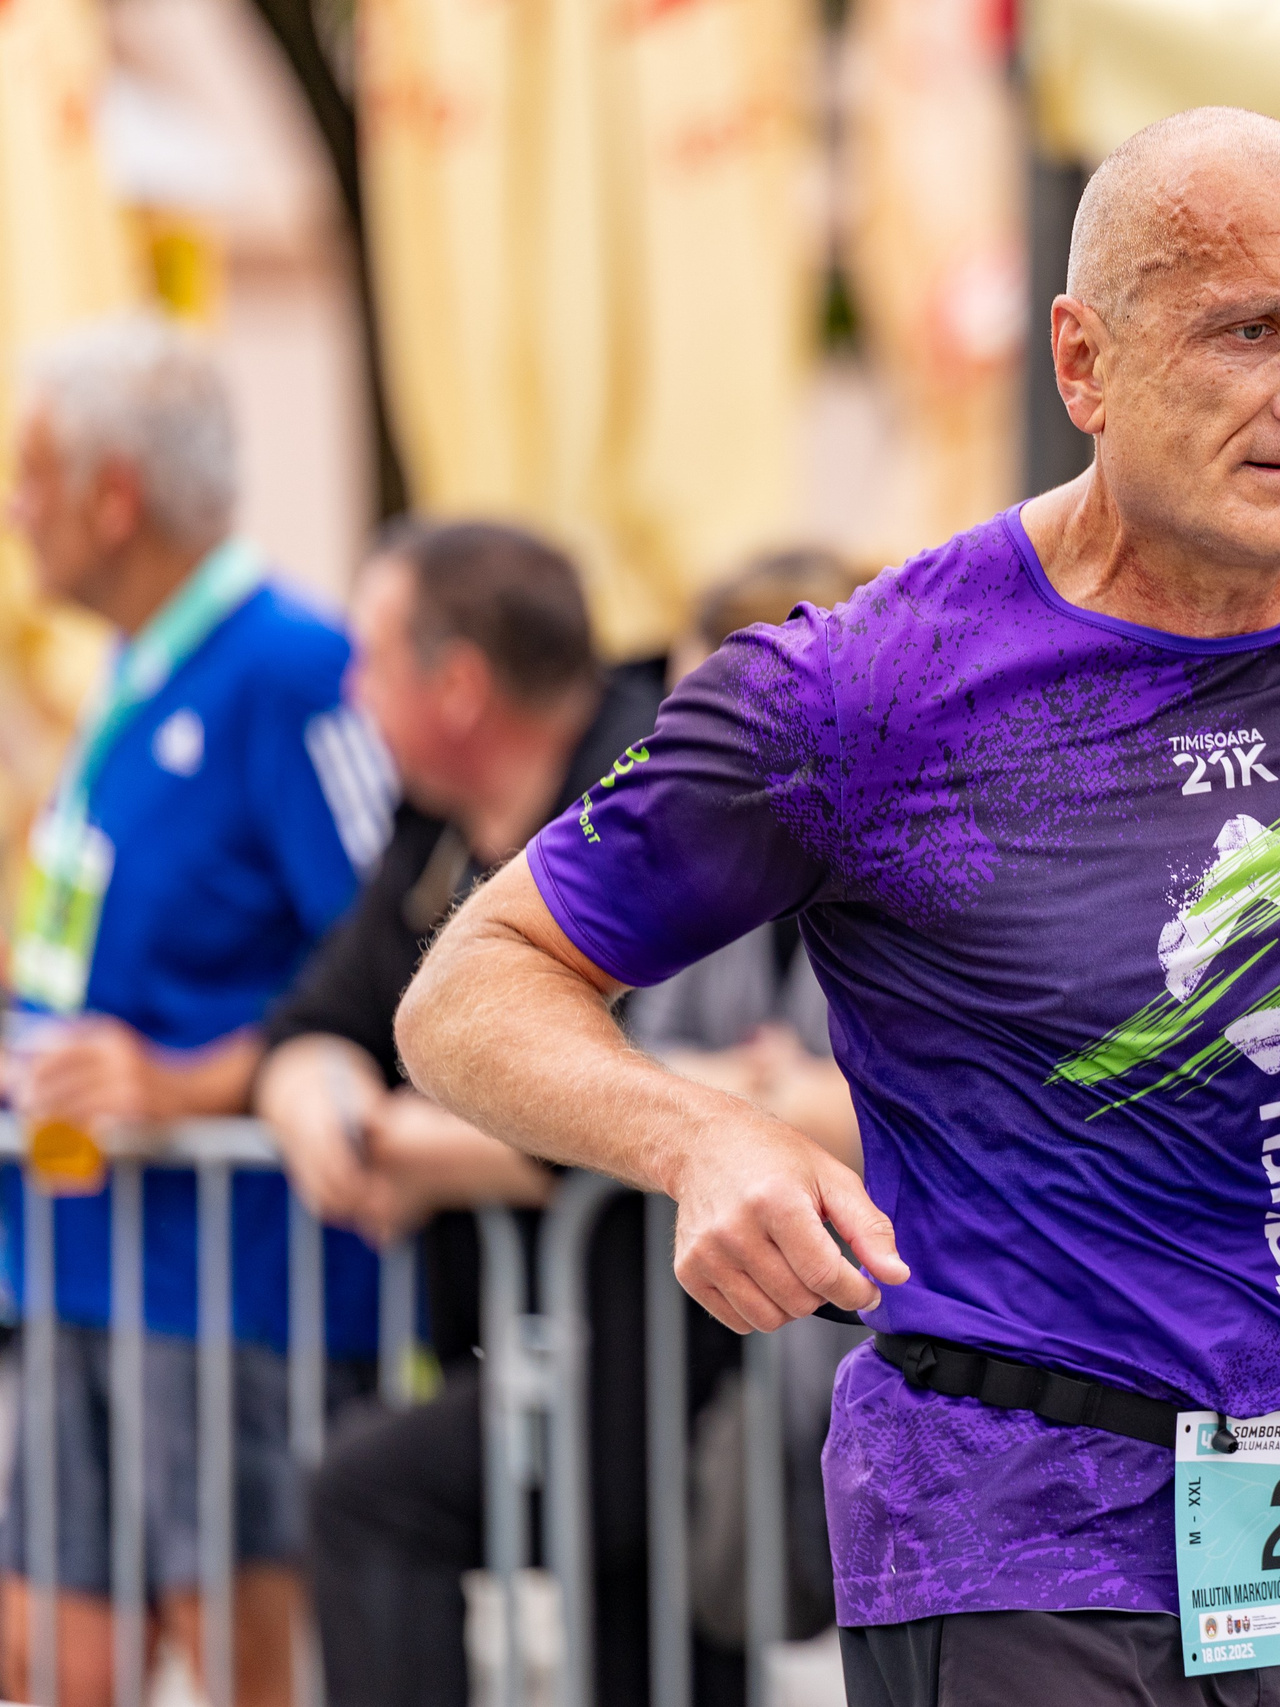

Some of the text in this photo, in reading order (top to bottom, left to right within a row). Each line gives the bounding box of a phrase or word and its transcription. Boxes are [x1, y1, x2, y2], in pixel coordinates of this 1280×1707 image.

[1172, 743, 1279, 796] 21K
[1188, 1476, 1201, 1507] XXL
[1189, 1531, 1201, 1545] M
[1192, 1585, 1232, 1609] MILUTIN
[1201, 1642, 1256, 1664] 18.05.2025.
